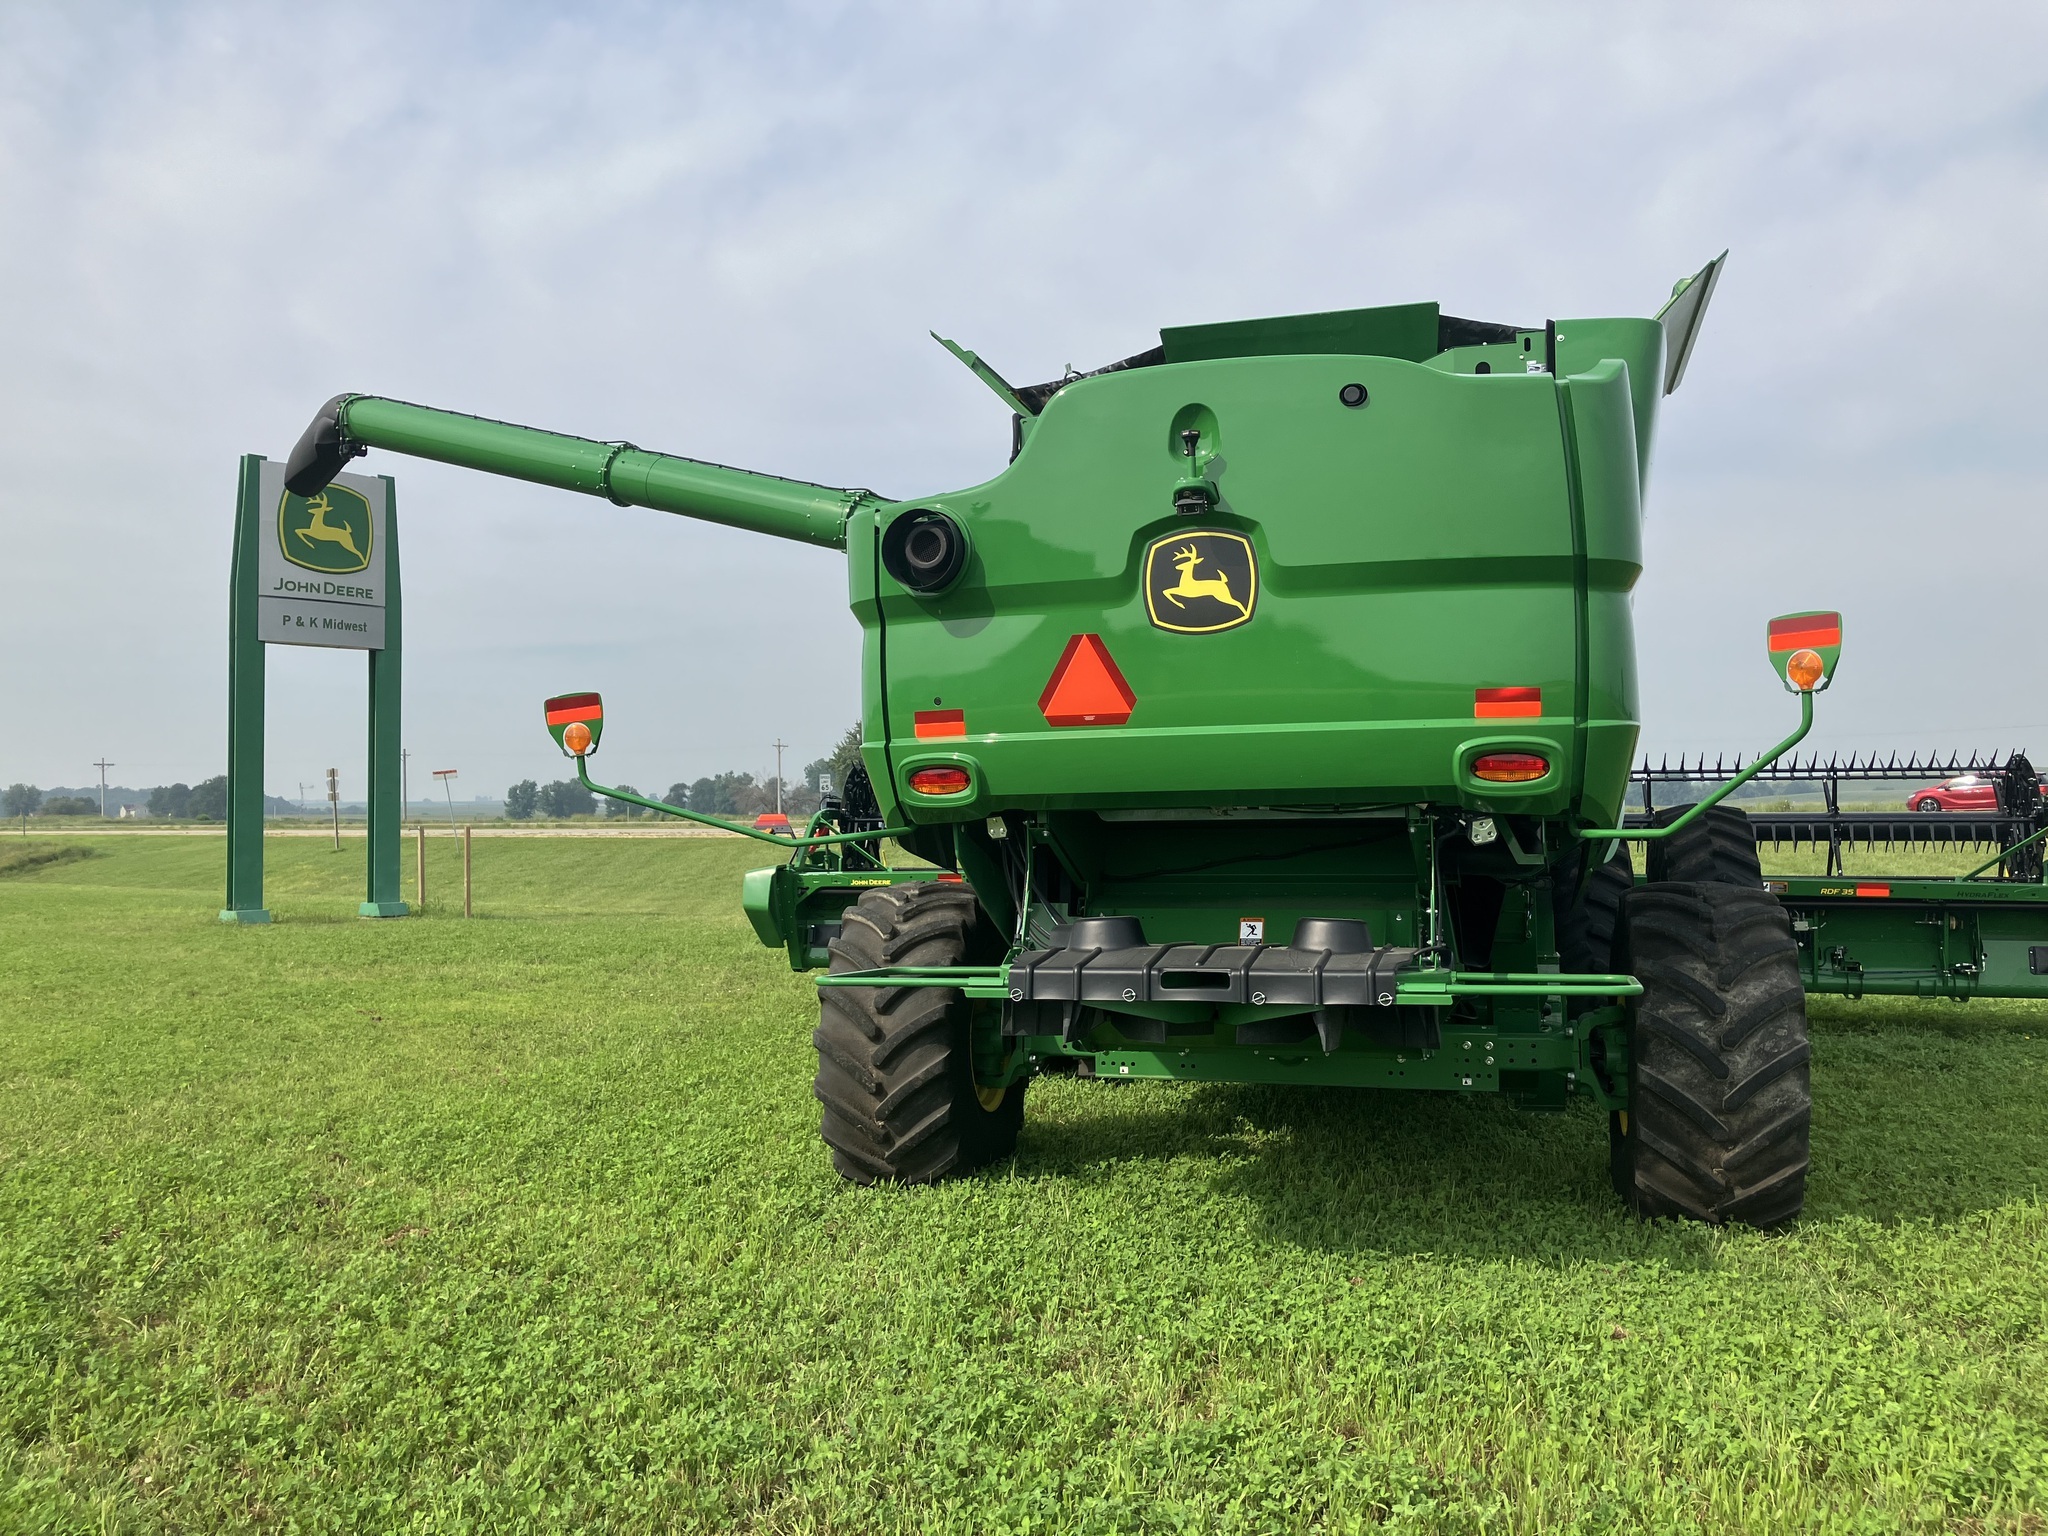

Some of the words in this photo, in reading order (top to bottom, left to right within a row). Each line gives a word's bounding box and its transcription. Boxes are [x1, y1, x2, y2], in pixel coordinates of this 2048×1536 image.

[274, 578, 320, 593] JOHN
[324, 582, 373, 599] DEERE
[282, 615, 291, 626] P
[296, 616, 305, 627] &
[310, 617, 318, 628] K
[322, 618, 367, 632] Midwest
